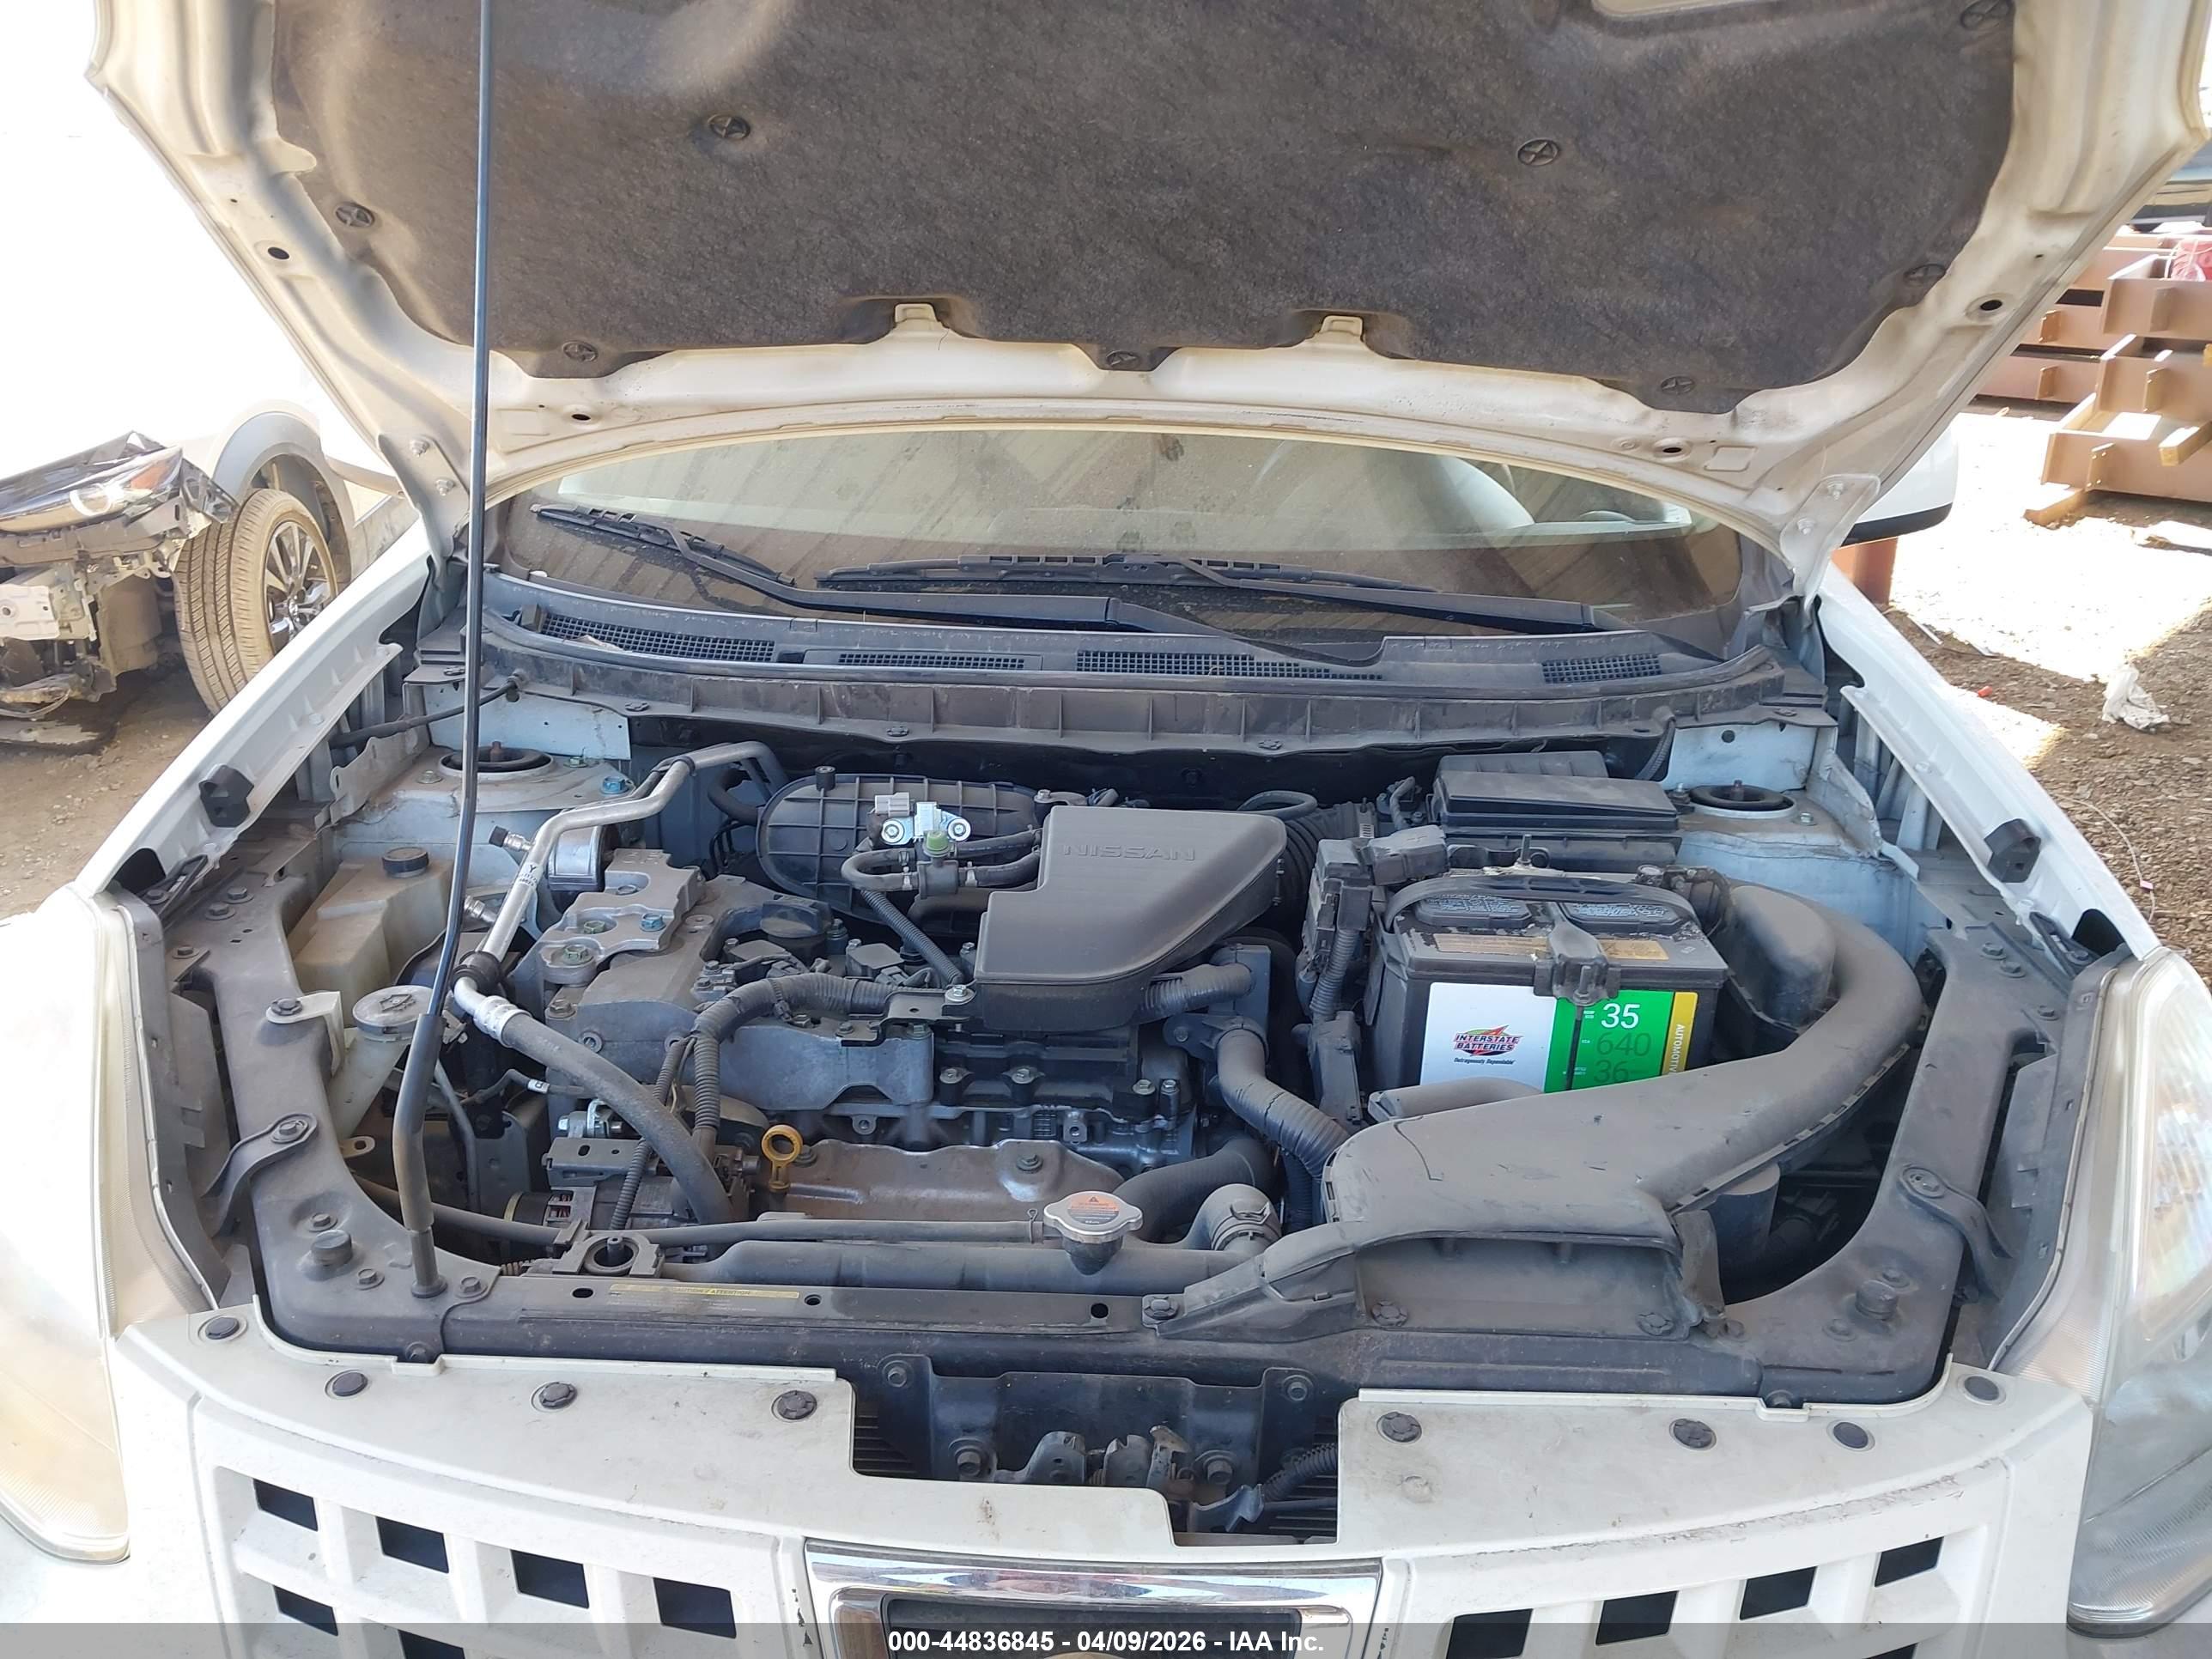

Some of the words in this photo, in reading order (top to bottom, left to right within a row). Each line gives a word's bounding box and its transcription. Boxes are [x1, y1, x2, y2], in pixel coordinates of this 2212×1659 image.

[1062, 844, 1195, 860] NISSAN
[1601, 1003, 1641, 1029] 35
[1455, 1034, 1519, 1043] INTERSTATE
[1456, 1042, 1514, 1051] BATTERIES
[1596, 1032, 1652, 1057] 640
[1668, 1024, 1686, 1073] AUTOMOTIV
[1593, 1059, 1629, 1083] 36
